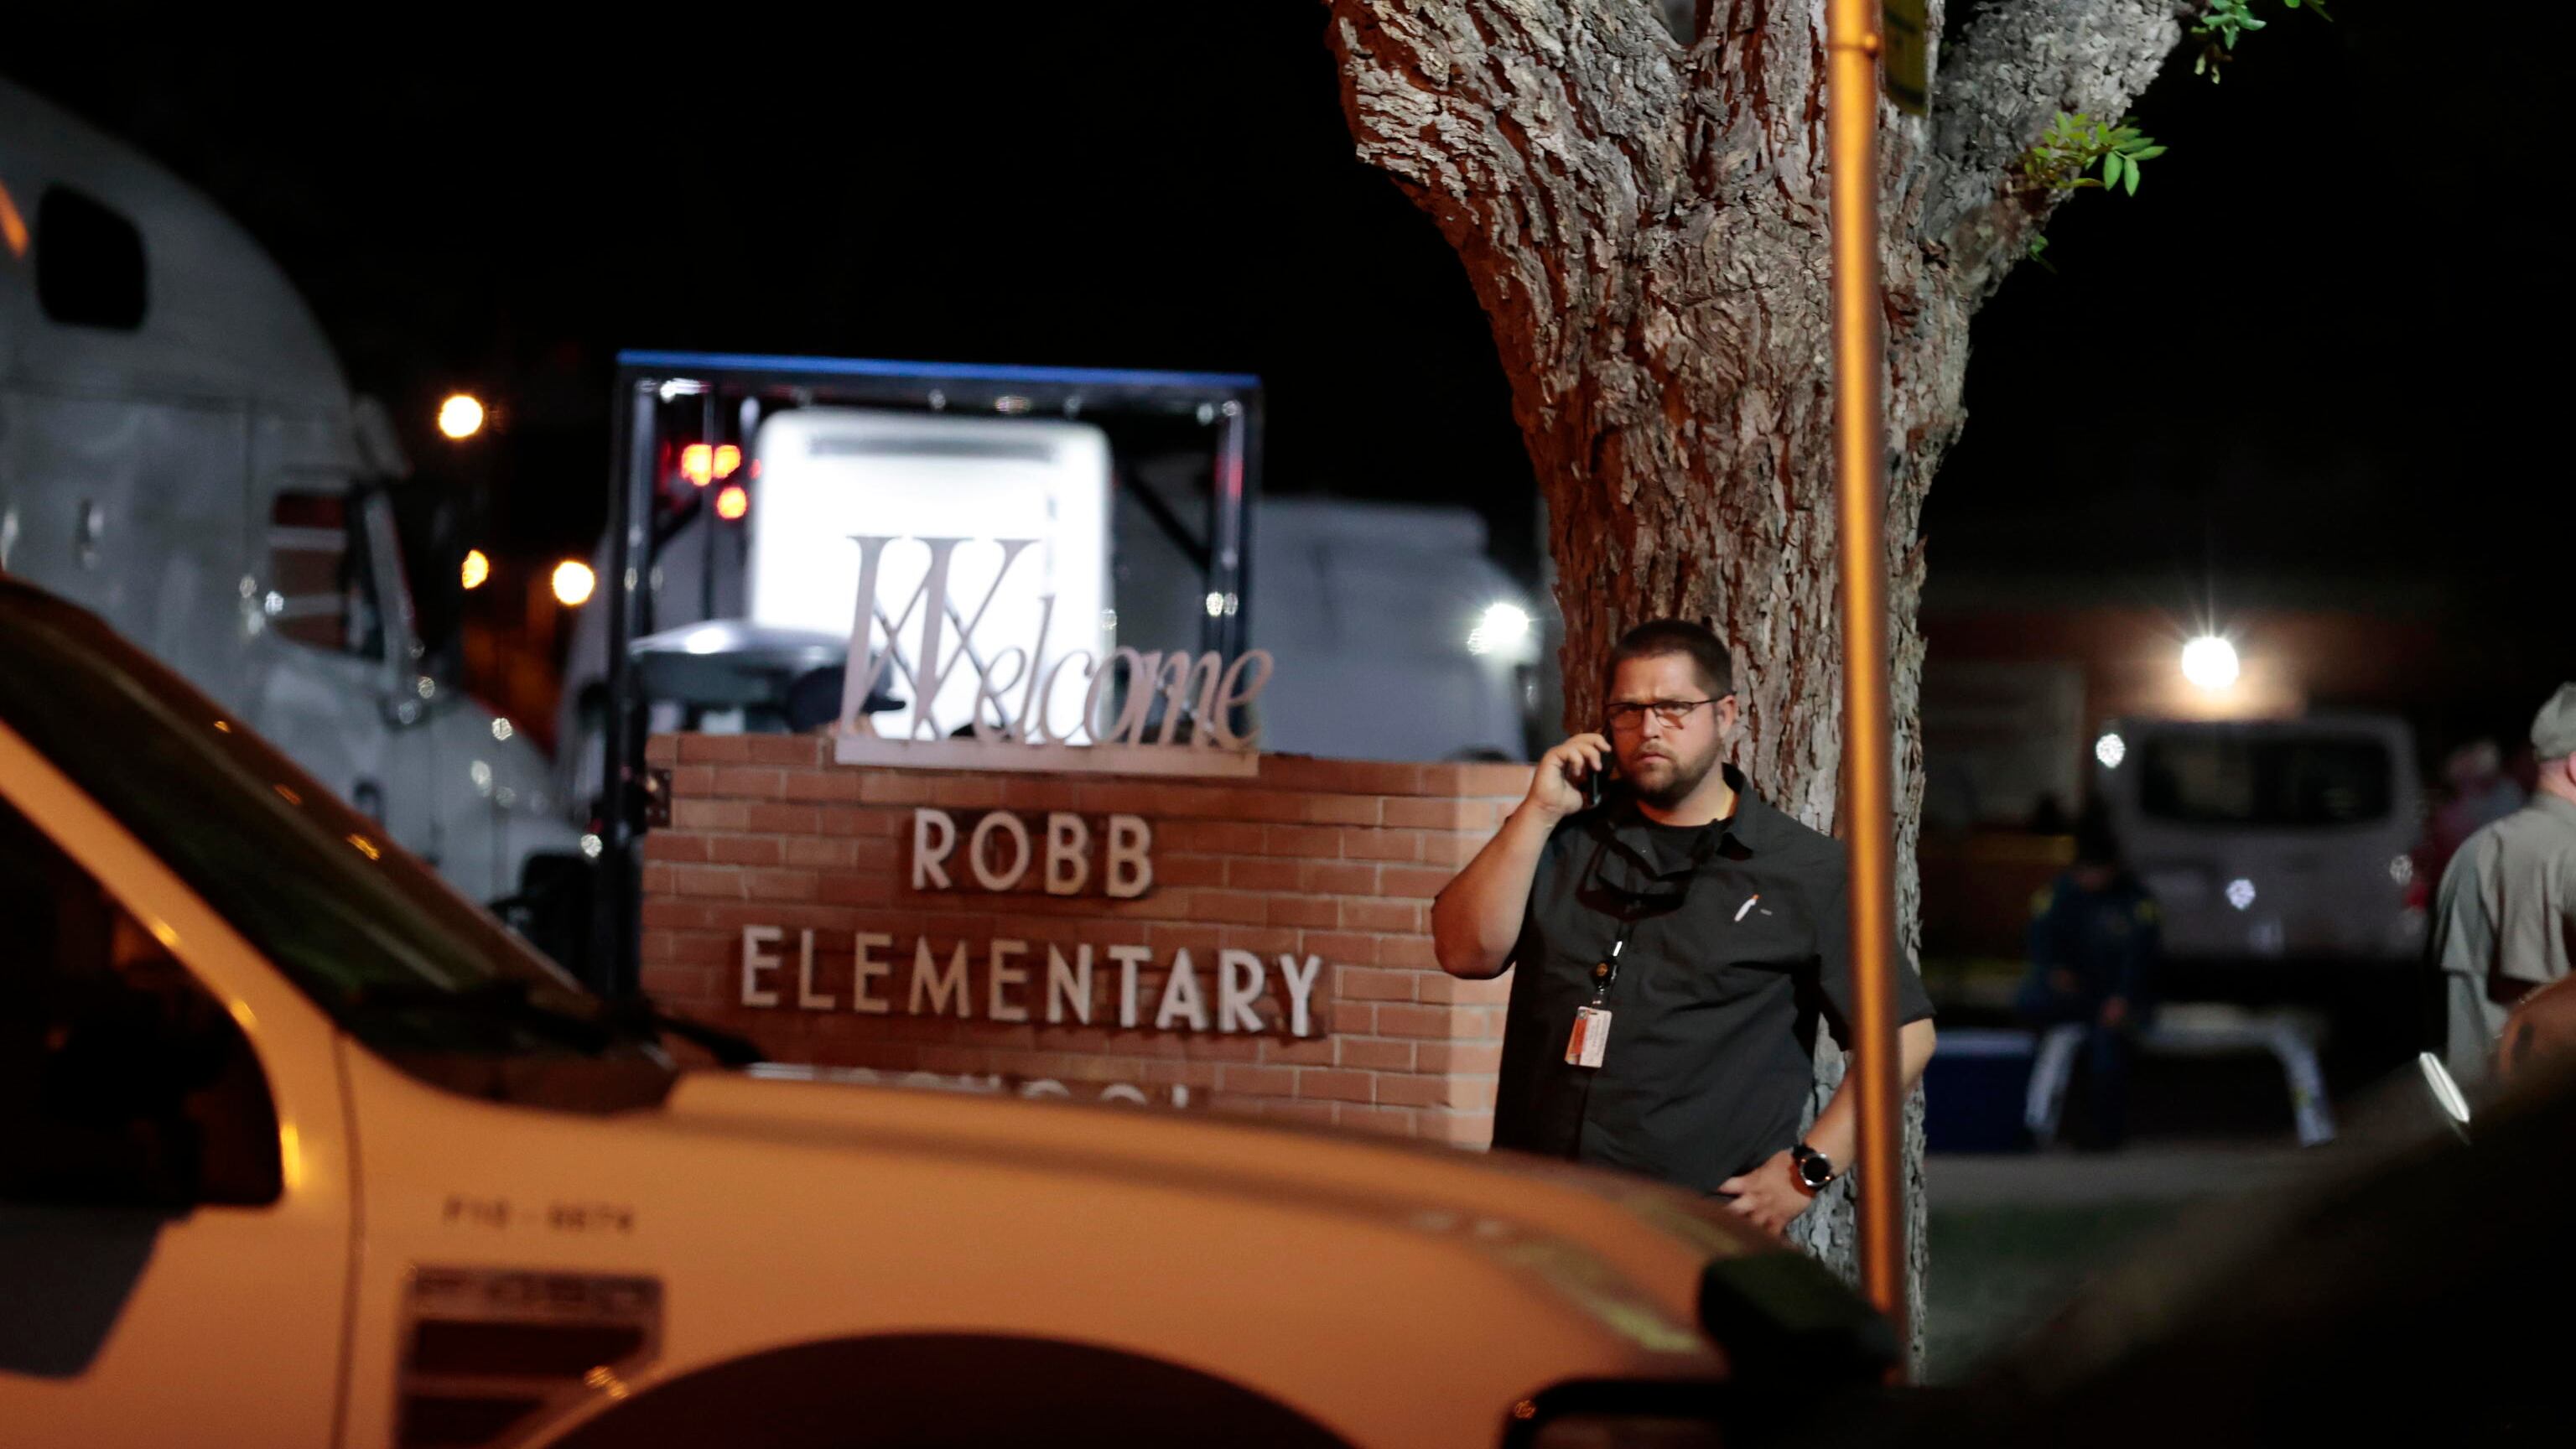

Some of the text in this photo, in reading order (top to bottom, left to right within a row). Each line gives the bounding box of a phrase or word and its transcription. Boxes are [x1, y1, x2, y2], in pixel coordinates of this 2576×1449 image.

[844, 534, 1275, 750] Welcome
[911, 807, 1154, 900] ROBB
[740, 925, 1322, 1038] ELEMENTARY
